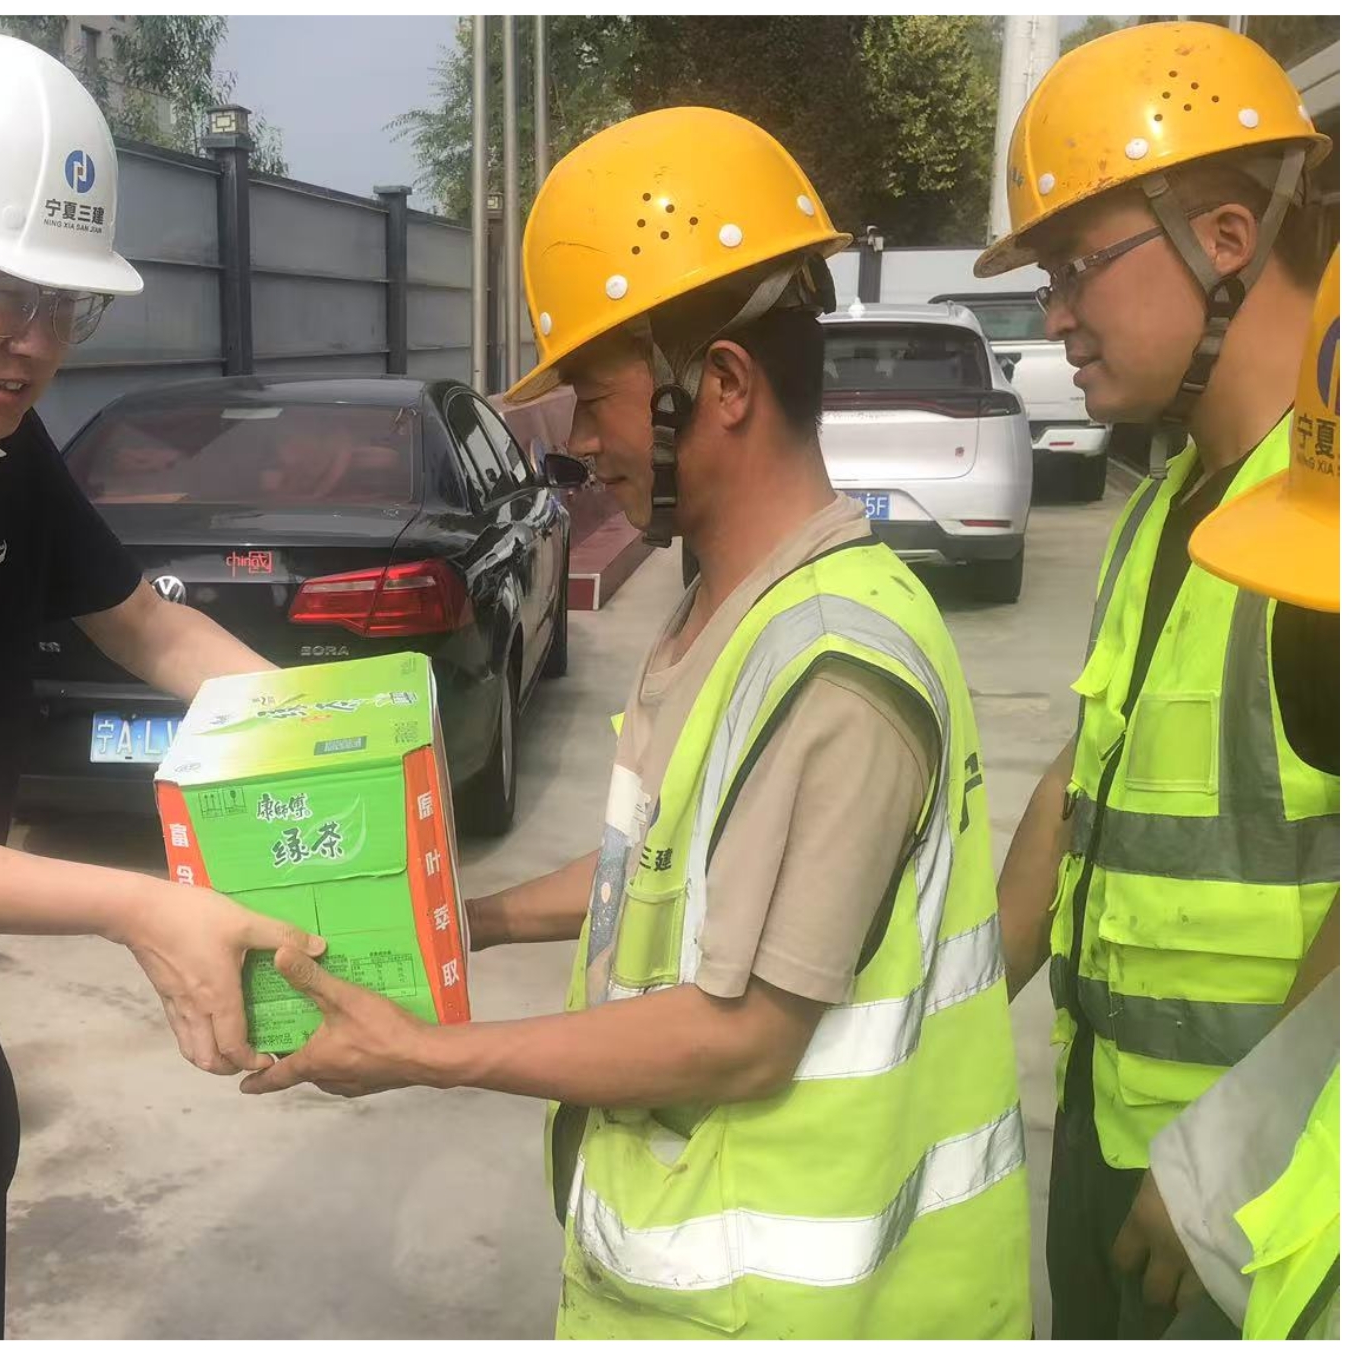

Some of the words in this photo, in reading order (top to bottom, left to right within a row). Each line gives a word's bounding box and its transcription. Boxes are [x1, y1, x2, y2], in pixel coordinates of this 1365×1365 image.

[45, 198, 104, 225] 宁夏三建
[1297, 413, 1336, 459] 宁夏
[272, 821, 344, 867] 绿茶
